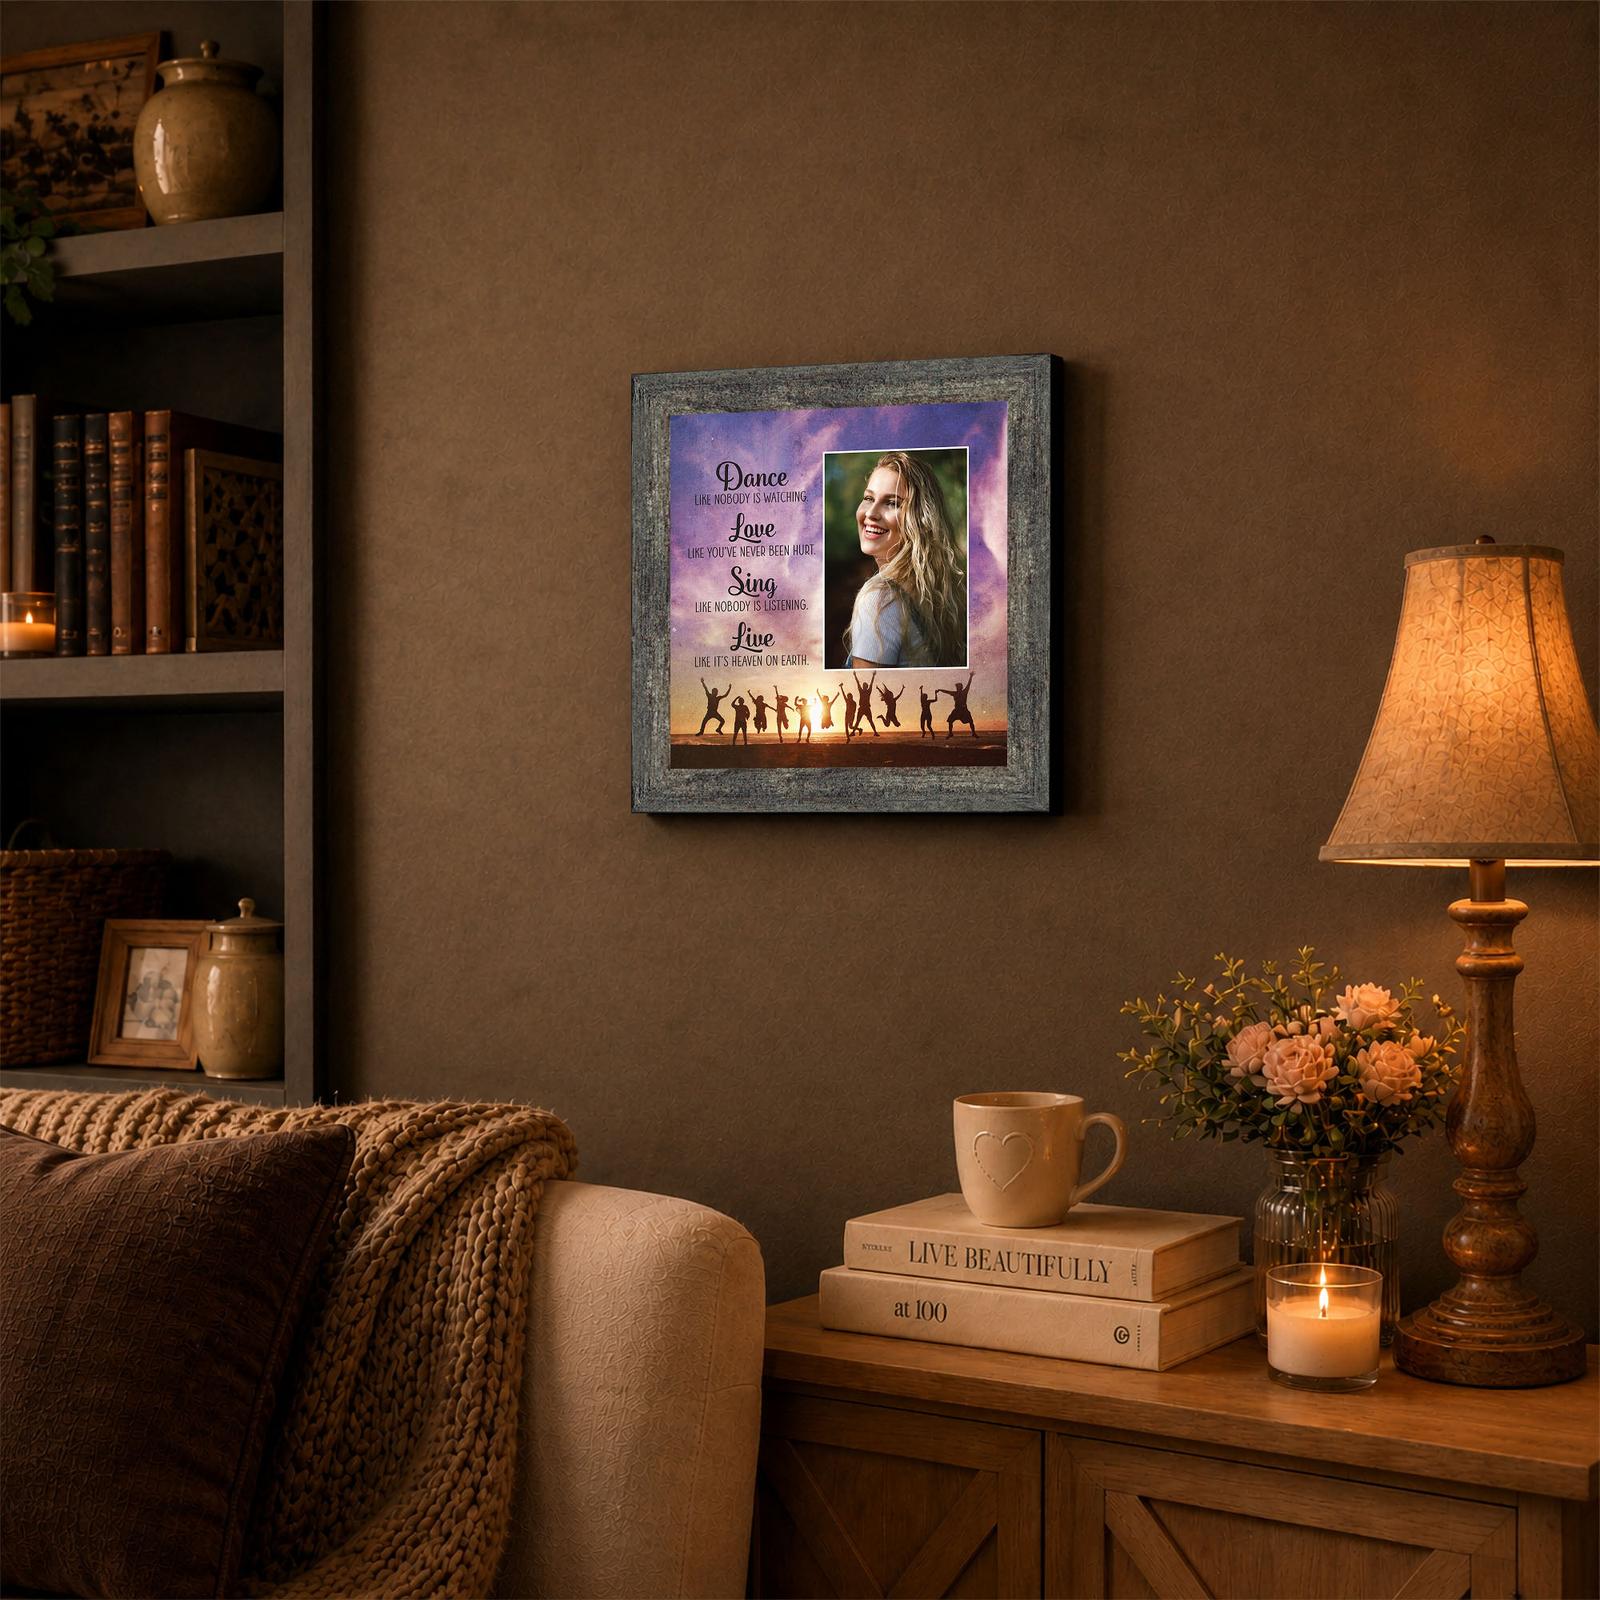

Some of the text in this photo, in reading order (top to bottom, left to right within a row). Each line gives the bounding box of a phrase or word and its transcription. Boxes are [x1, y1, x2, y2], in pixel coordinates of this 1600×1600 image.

[716, 461, 789, 491] Dance
[695, 490, 809, 506] LIKE NOBODY IS WATCHING.
[728, 512, 776, 543] Love
[687, 543, 816, 559] LIKE YOU'VE NEVER BEEN HURT.
[728, 565, 777, 599] Sing
[695, 599, 809, 613] LIKE NOBODY IS LISTENING.
[730, 621, 776, 653] Live
[694, 654, 810, 668] LIKE IT'S HEAVEN ON EARTH.
[909, 1240, 958, 1267] LIVE
[964, 1246, 1113, 1284] BEAUTIFULLY
[894, 1299, 948, 1323] at 100
